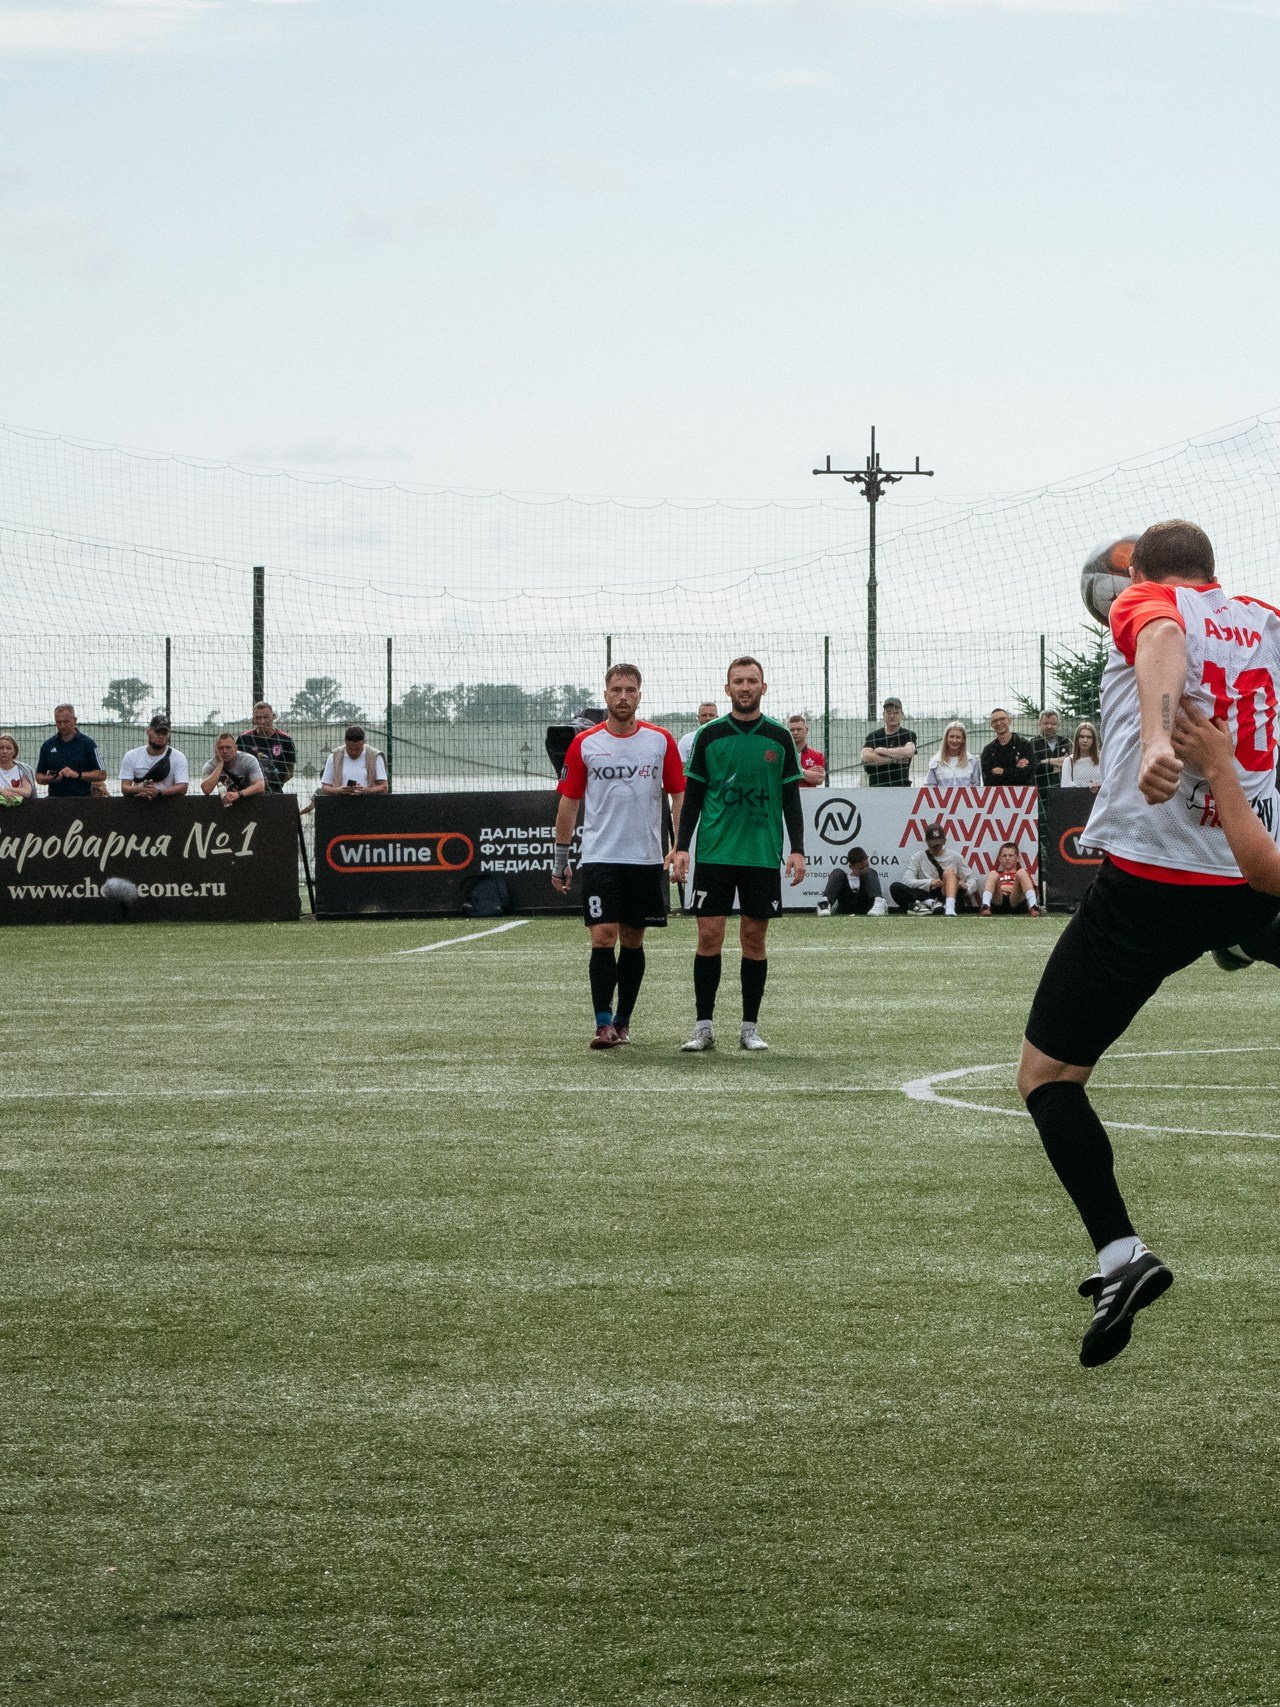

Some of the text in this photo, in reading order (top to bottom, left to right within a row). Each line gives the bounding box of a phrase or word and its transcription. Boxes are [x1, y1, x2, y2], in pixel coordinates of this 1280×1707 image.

[0, 819, 172, 874] ыроварня
[340, 843, 431, 864] Winline
[7, 876, 227, 900] www.cheone.ru
[588, 895, 603, 918] 8
